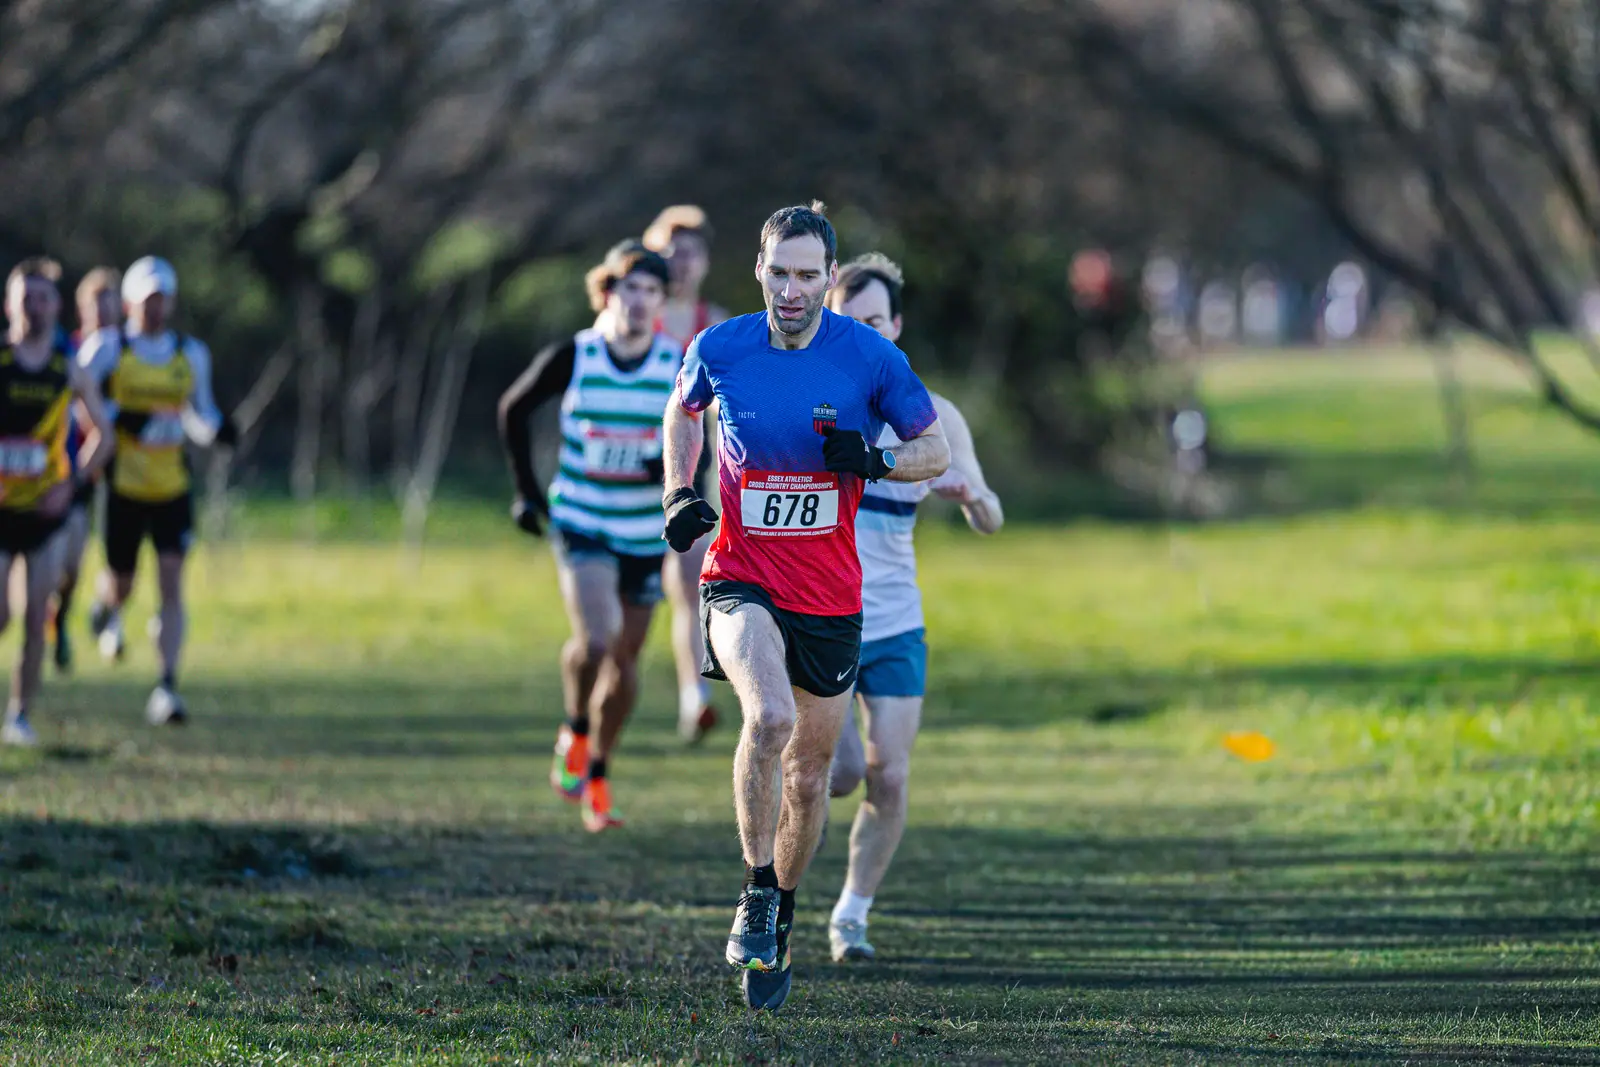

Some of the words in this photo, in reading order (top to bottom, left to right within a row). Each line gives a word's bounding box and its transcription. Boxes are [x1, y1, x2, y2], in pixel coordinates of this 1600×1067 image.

[738, 411, 756, 419] TACTIC
[785, 475, 813, 483] ATHLETICS
[765, 481, 790, 490] COUNTRY
[790, 481, 834, 490] CHAMPIONSHIPS
[763, 493, 820, 527] 678
